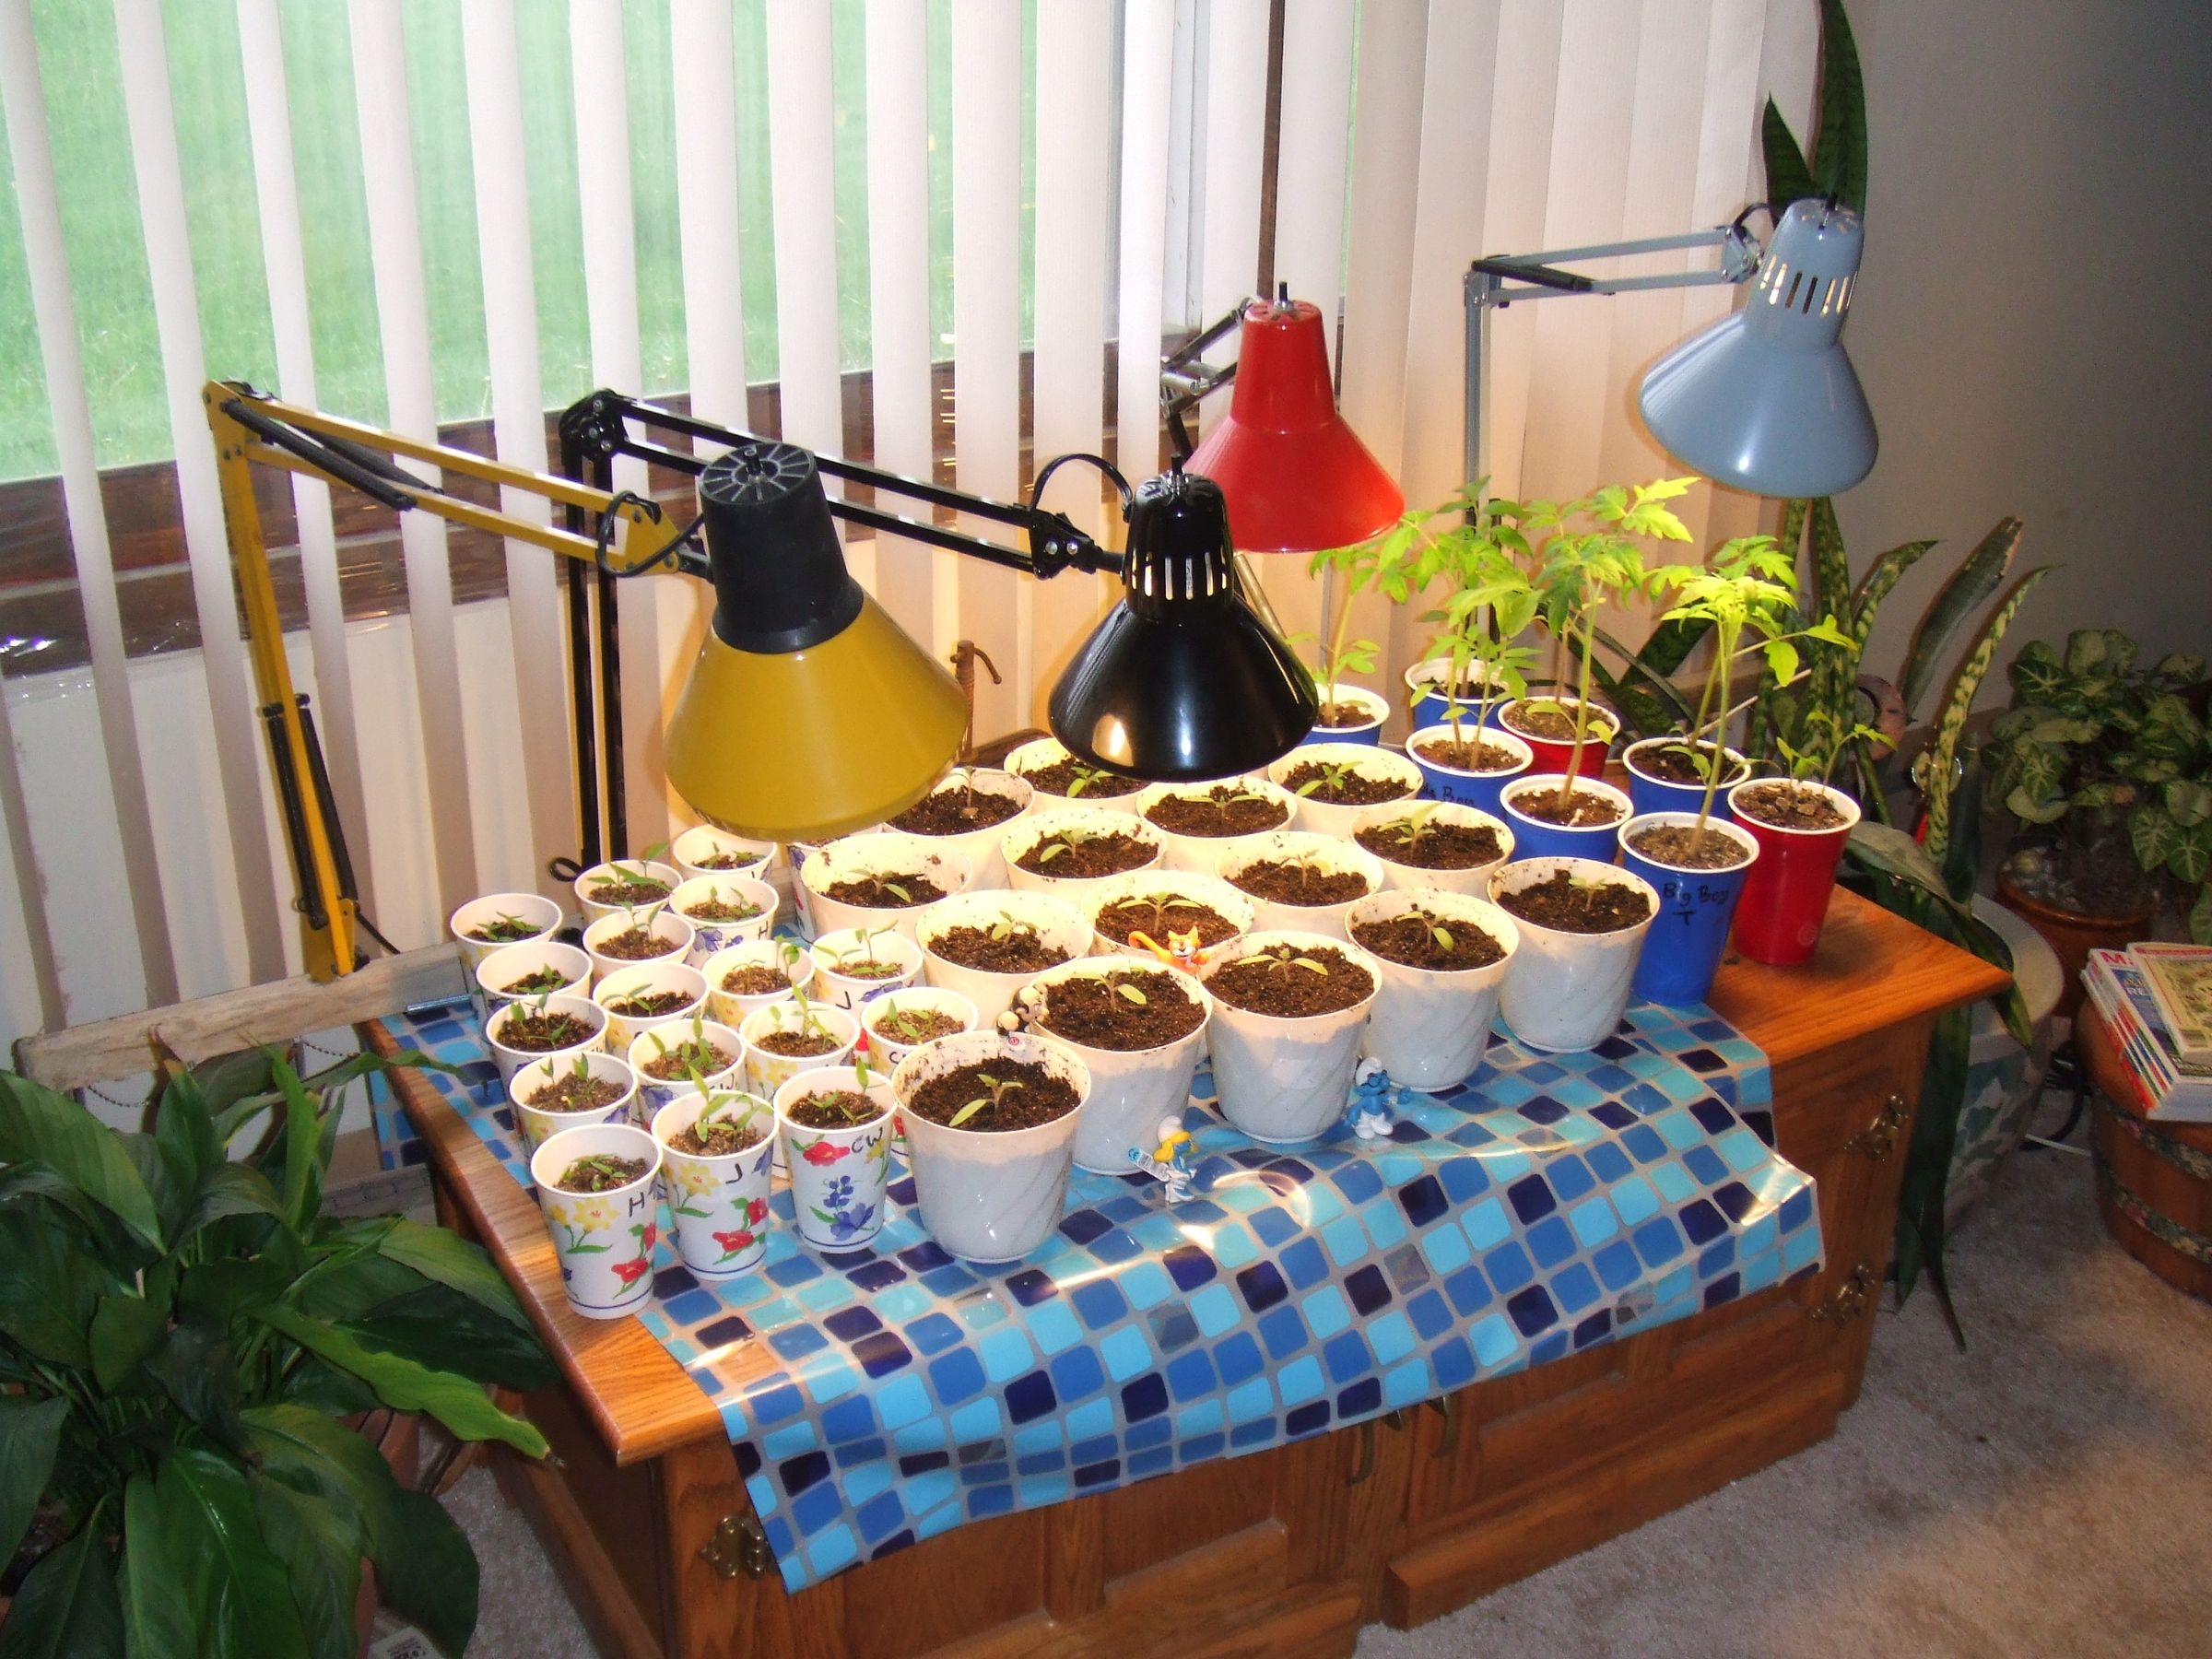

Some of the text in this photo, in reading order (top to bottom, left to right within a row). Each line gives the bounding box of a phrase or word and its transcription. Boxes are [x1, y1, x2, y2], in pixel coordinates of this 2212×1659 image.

[1663, 882, 1692, 907] Big
[1673, 909, 1697, 926] T
[757, 920, 770, 940] H
[835, 990, 853, 1010] J
[851, 1126, 884, 1154] CW
[724, 1162, 744, 1185] J
[629, 1191, 645, 1218] H
